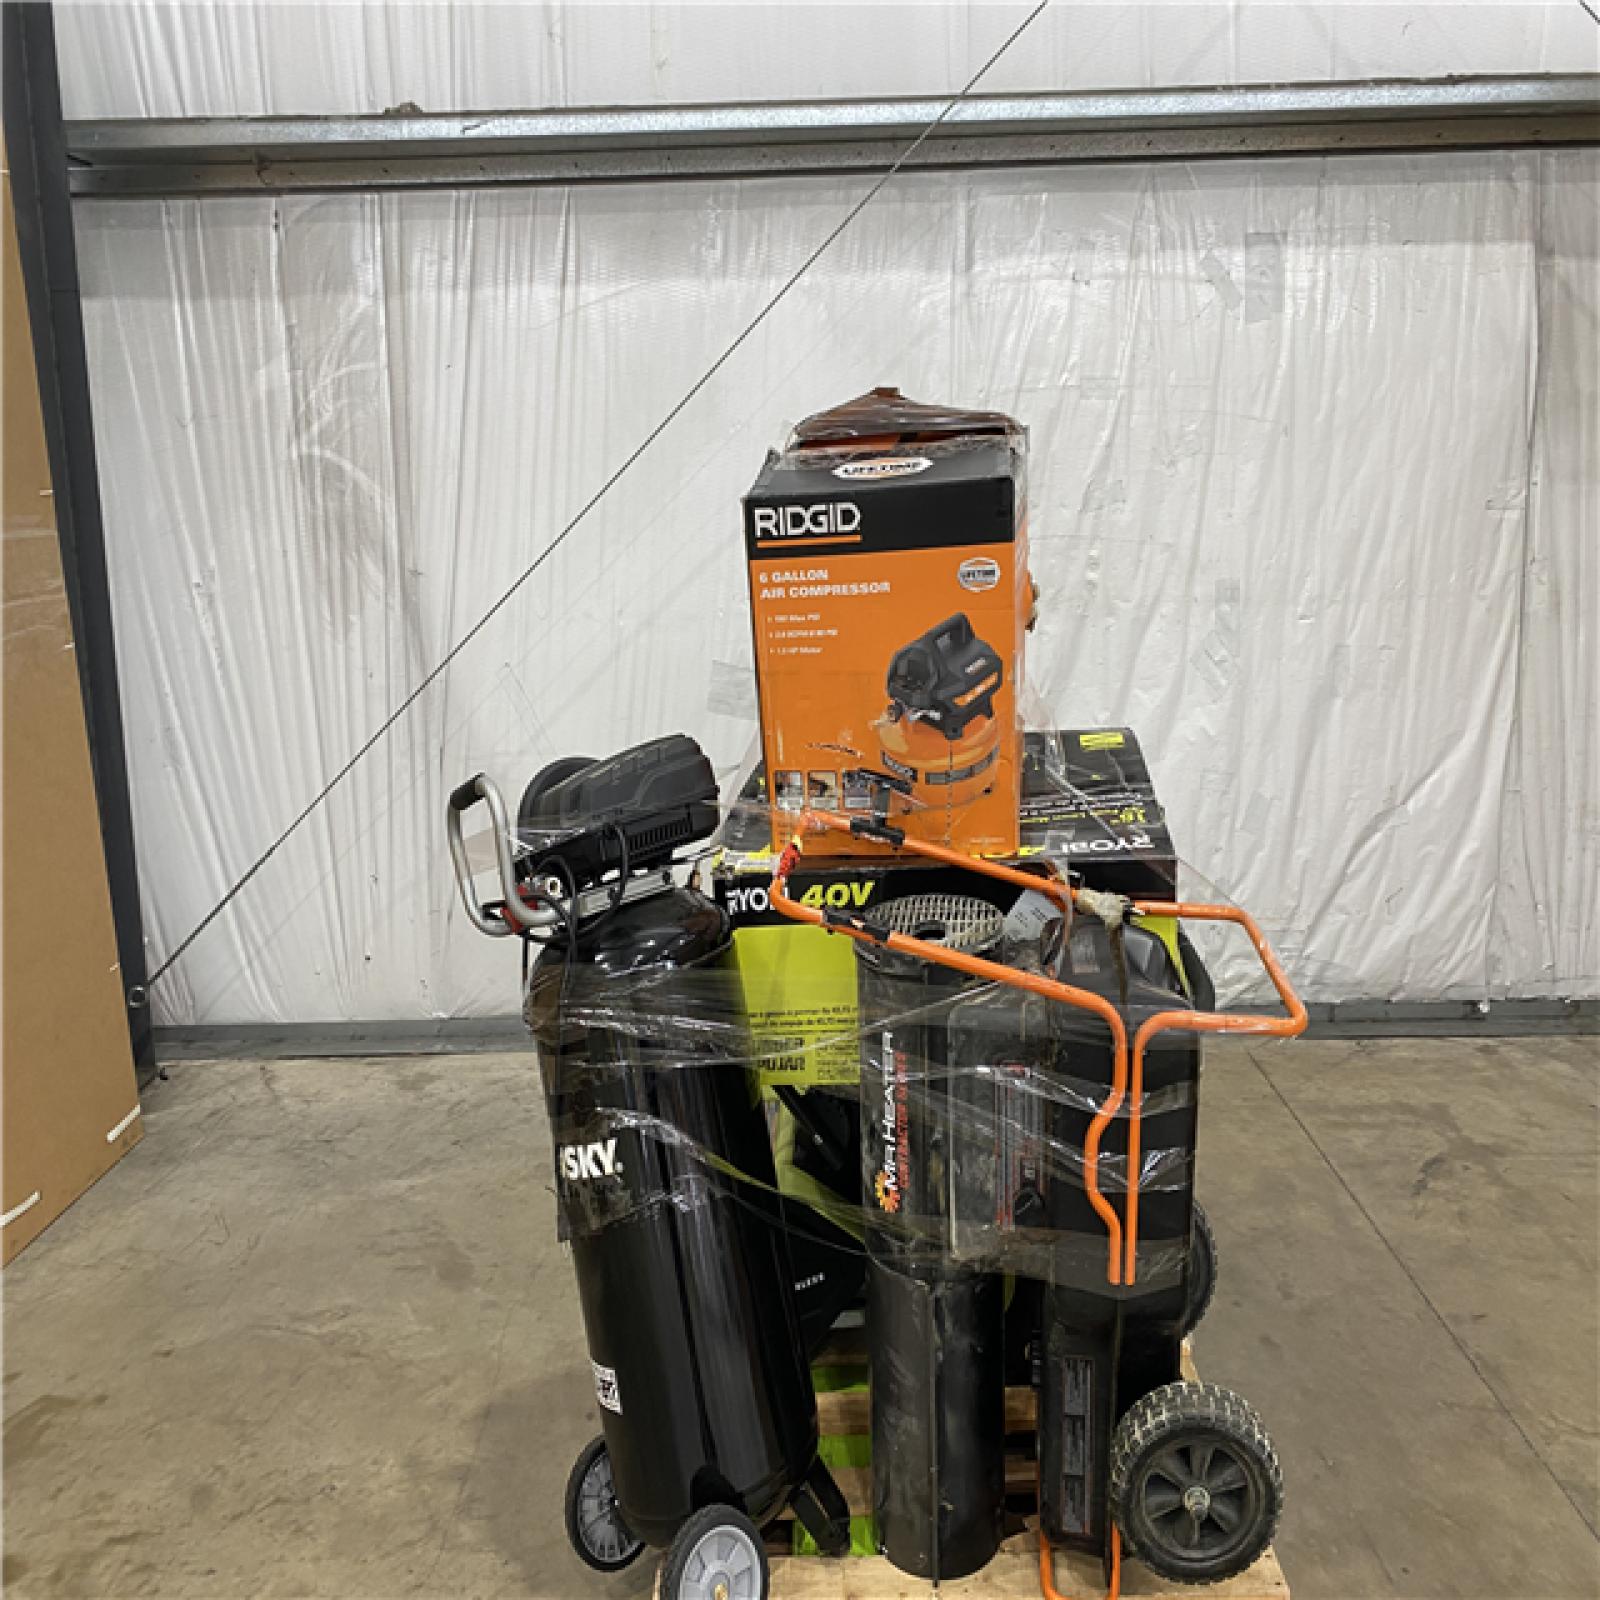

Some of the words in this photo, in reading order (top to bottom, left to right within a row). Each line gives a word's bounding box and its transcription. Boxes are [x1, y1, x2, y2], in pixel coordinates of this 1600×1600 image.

[754, 502, 861, 537] RIDGID
[772, 569, 828, 583] GALLON
[760, 587, 785, 599] AIR
[789, 582, 890, 598] COMPRESSOR
[1060, 835, 1155, 853] RYOBI
[725, 887, 789, 915] RYOI
[802, 879, 876, 909] 40V
